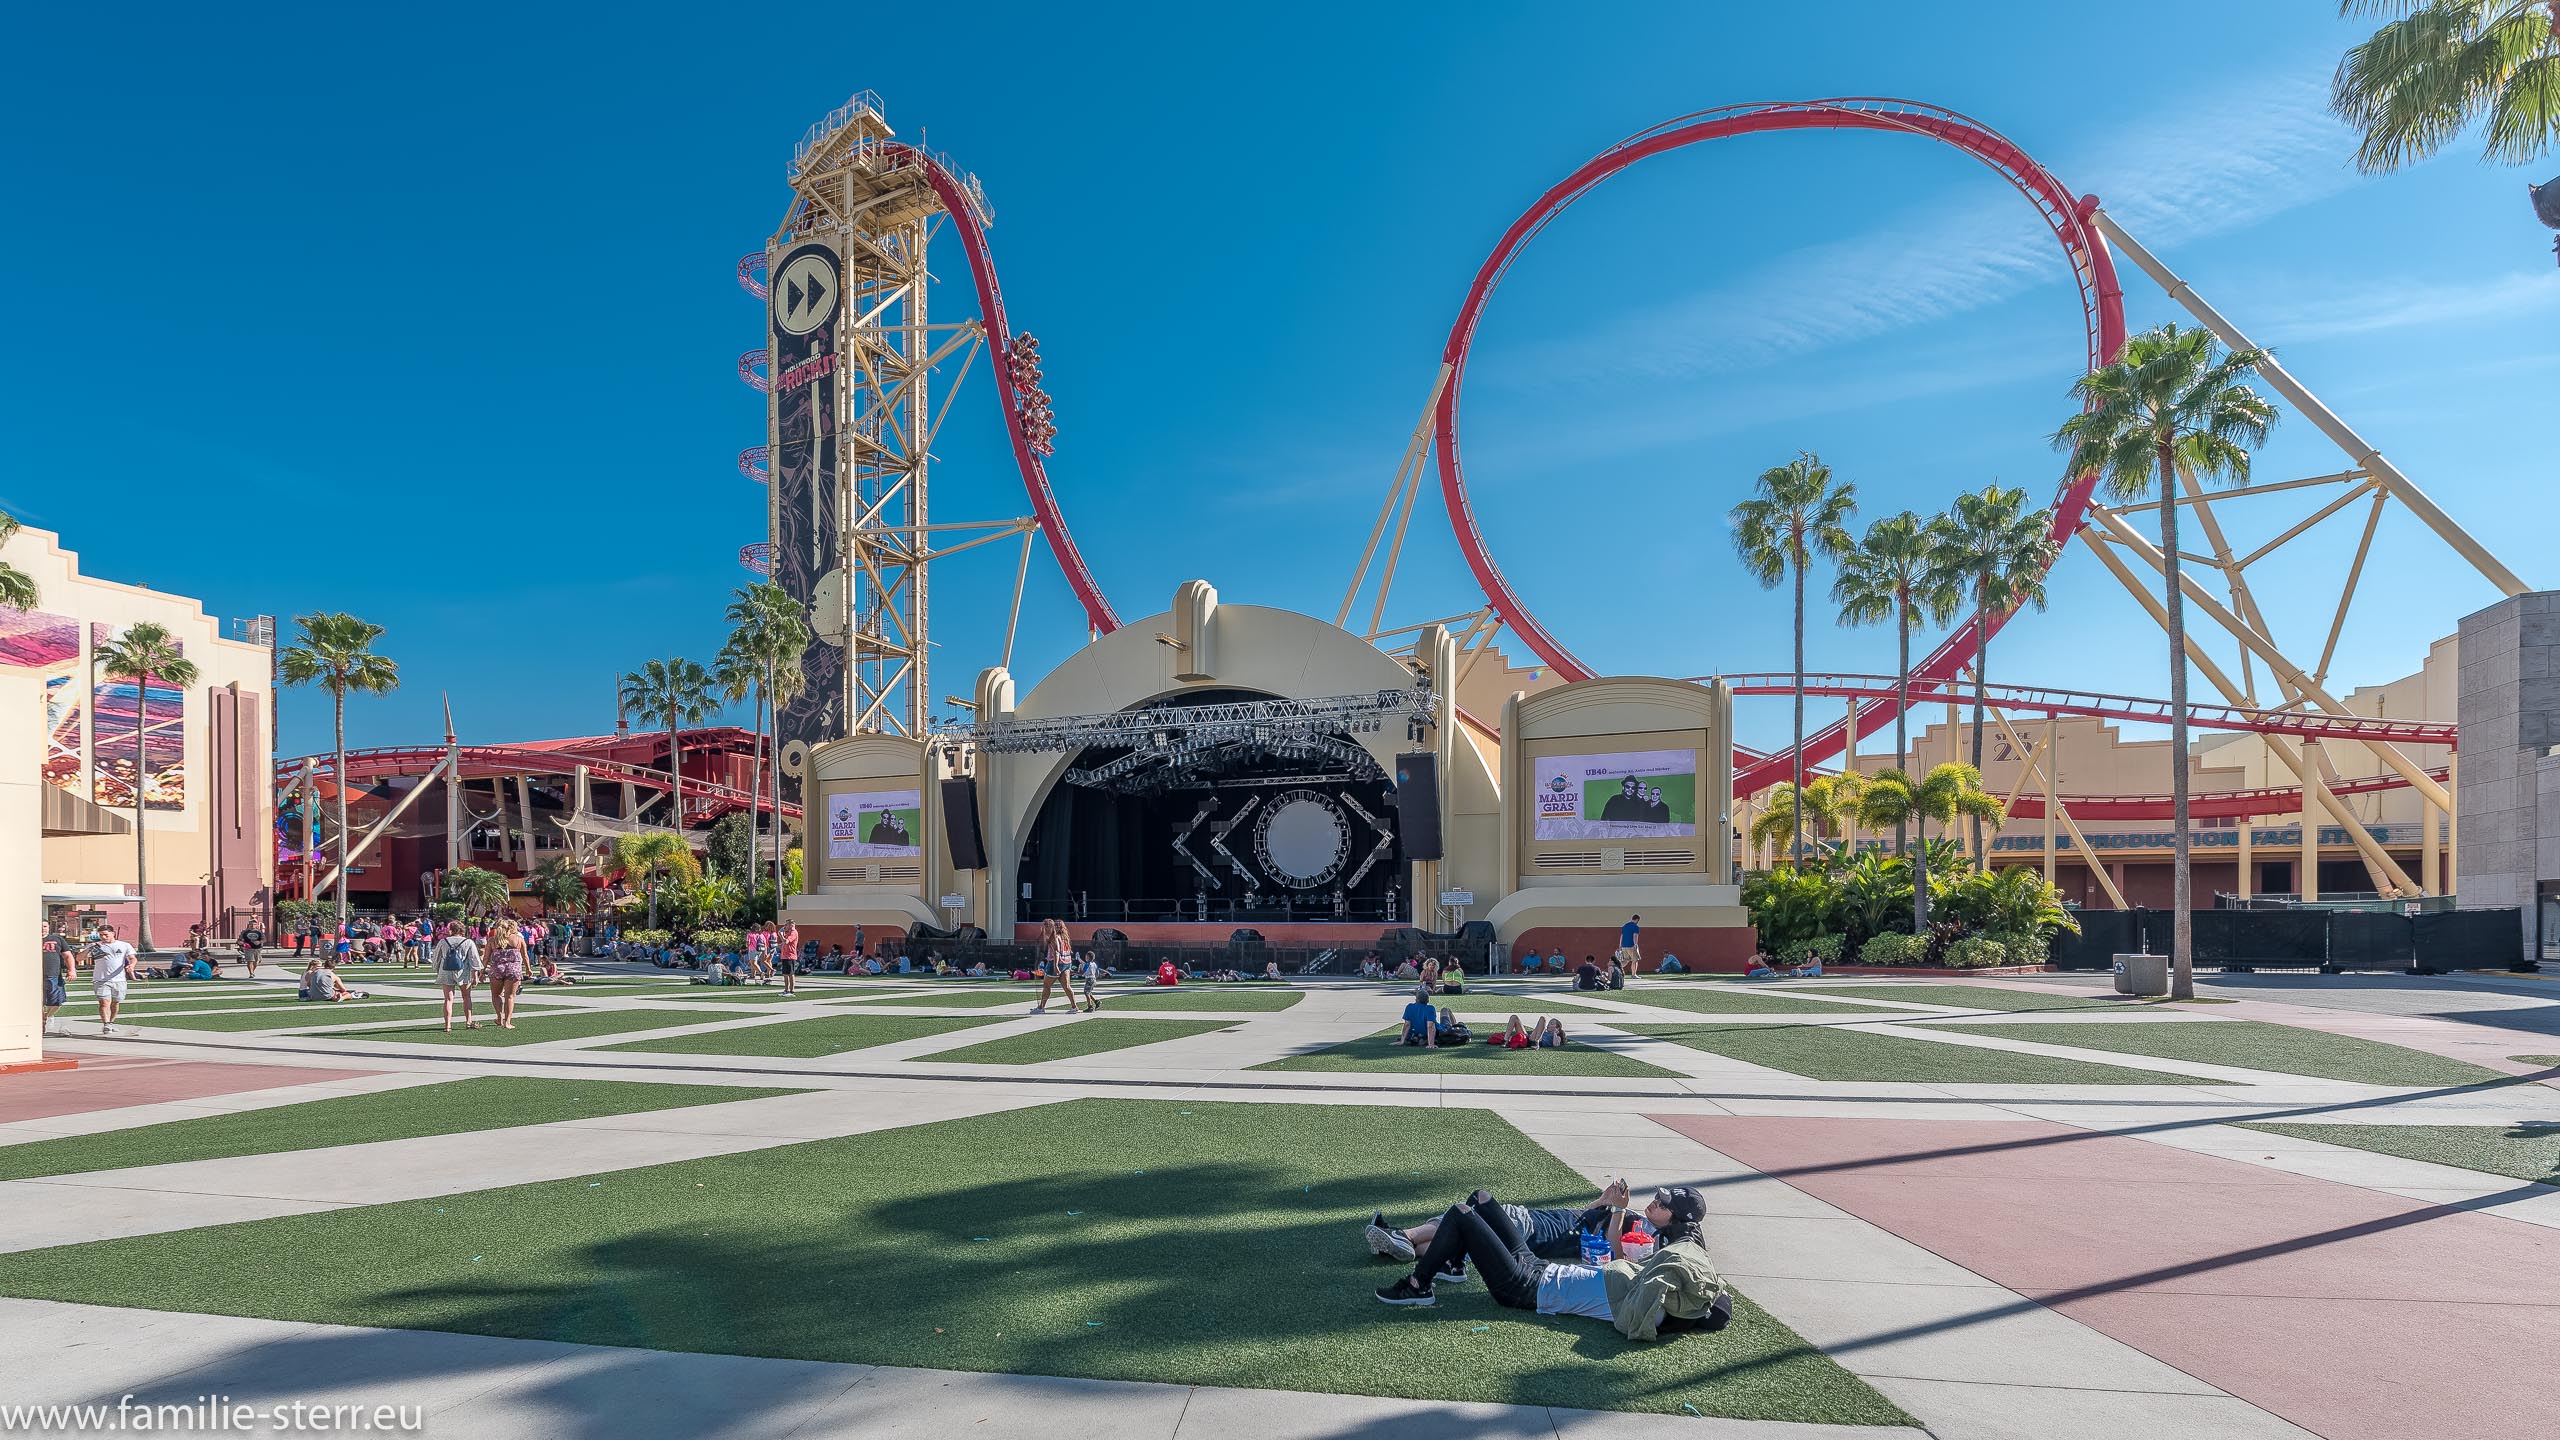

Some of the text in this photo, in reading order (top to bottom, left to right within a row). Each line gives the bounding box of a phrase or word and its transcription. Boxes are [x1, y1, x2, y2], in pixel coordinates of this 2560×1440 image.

[785, 353, 821, 374] HOLLYWOOD
[785, 353, 838, 392] ROCKIT
[1995, 732, 2031, 740] STGE
[1585, 768, 1607, 776] UB40
[1539, 793, 1579, 803] MARDI
[1543, 803, 1575, 812] GRAS
[2083, 832, 2239, 849] PRODUCION
[2251, 829, 2389, 846] FACITS
